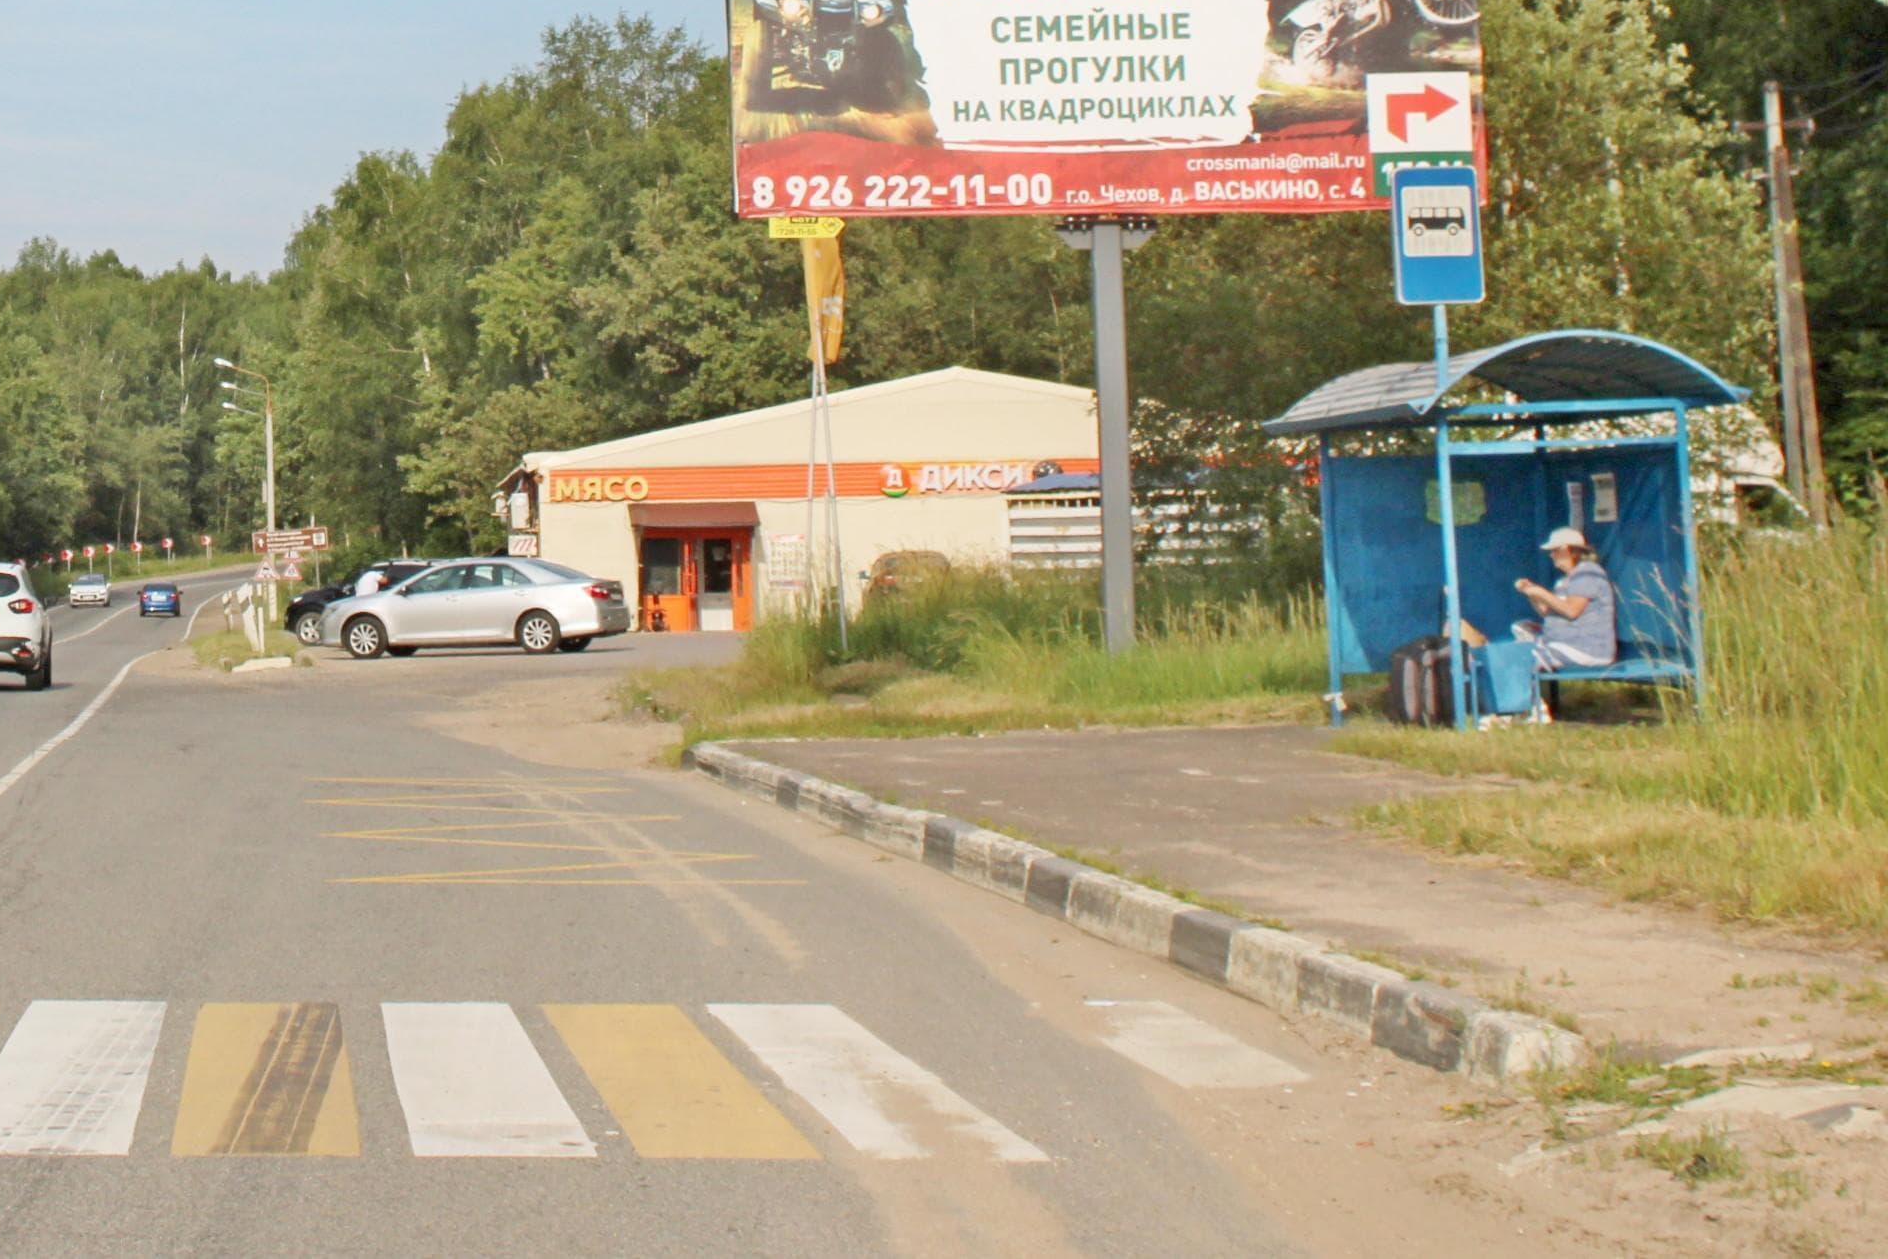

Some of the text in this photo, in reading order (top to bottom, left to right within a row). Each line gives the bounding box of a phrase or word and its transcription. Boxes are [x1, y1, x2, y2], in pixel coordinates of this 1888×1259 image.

[990, 7, 1191, 43] СЕМЕЙНЫЕ
[999, 55, 1186, 85] ПРОГУЛКИ
[953, 94, 1237, 124] НА КВАДРОЦИКЛАХ
[1186, 153, 1366, 172] crossmania@mail.ru
[752, 173, 1053, 208] 8 926 222-11-00
[1065, 177, 1366, 205] г.о. Чехов, д. ВАСЬКИНО, с. 4
[555, 475, 649, 502] МЯСО
[918, 464, 1026, 492] ДИКСИ
